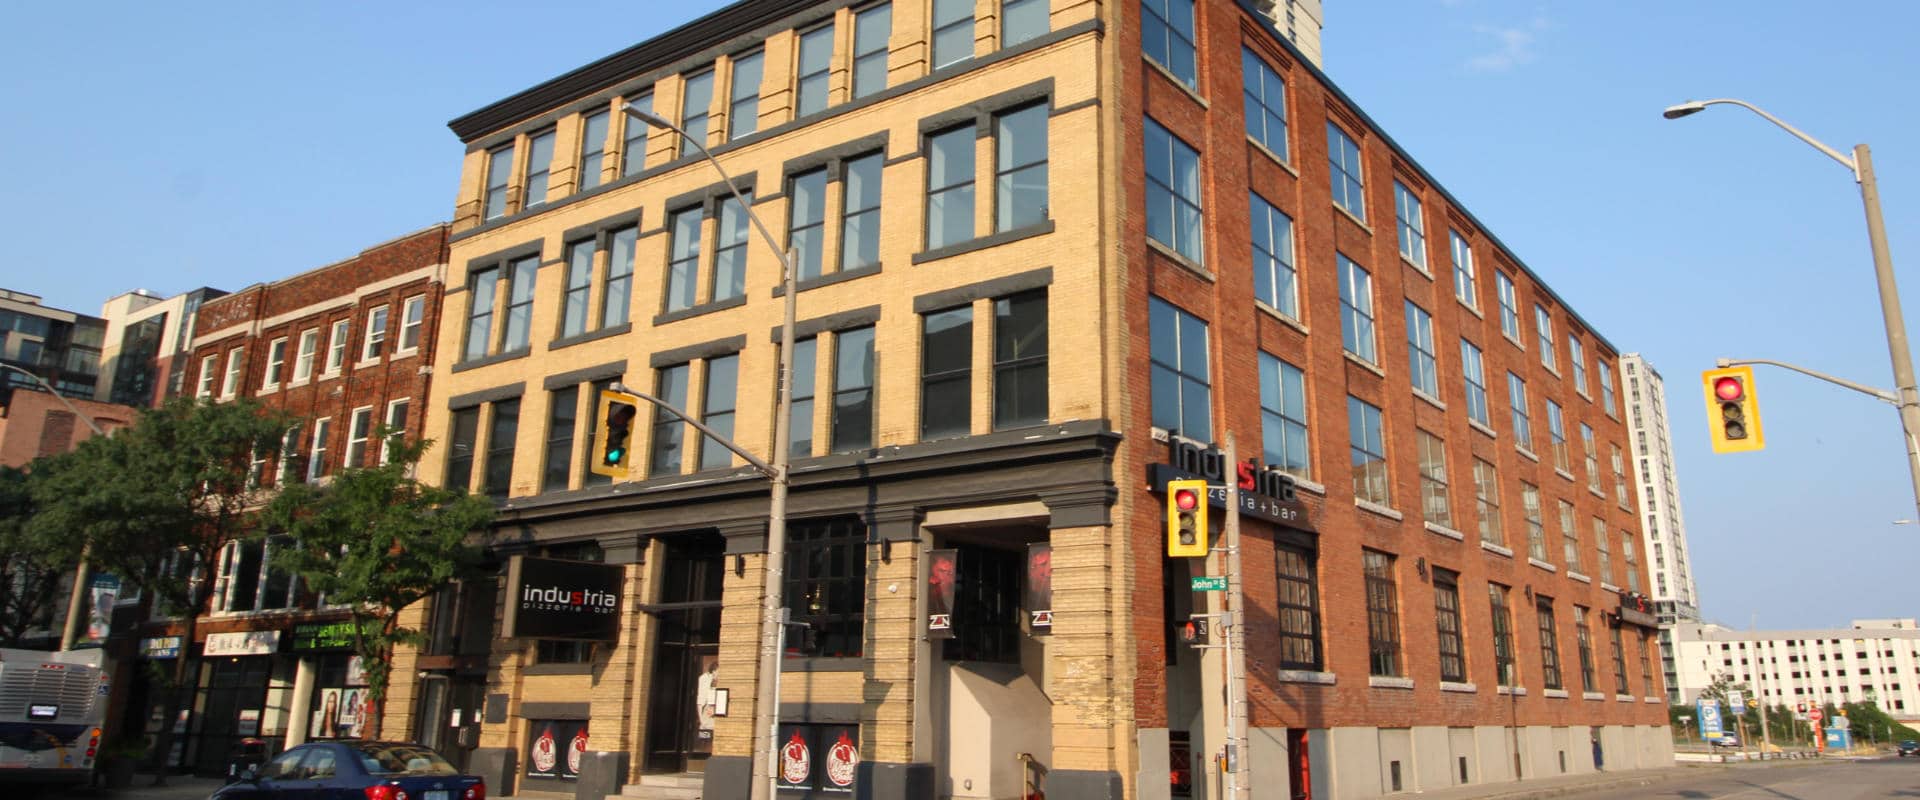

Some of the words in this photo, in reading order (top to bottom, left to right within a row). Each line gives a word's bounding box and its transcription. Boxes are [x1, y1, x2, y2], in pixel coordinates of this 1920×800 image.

[1271, 501, 1297, 521] bar
[1192, 579, 1213, 589] John
[1219, 579, 1226, 589] S
[524, 584, 617, 607] industria
[523, 602, 582, 612] pizzeria
[594, 606, 615, 615] bar
